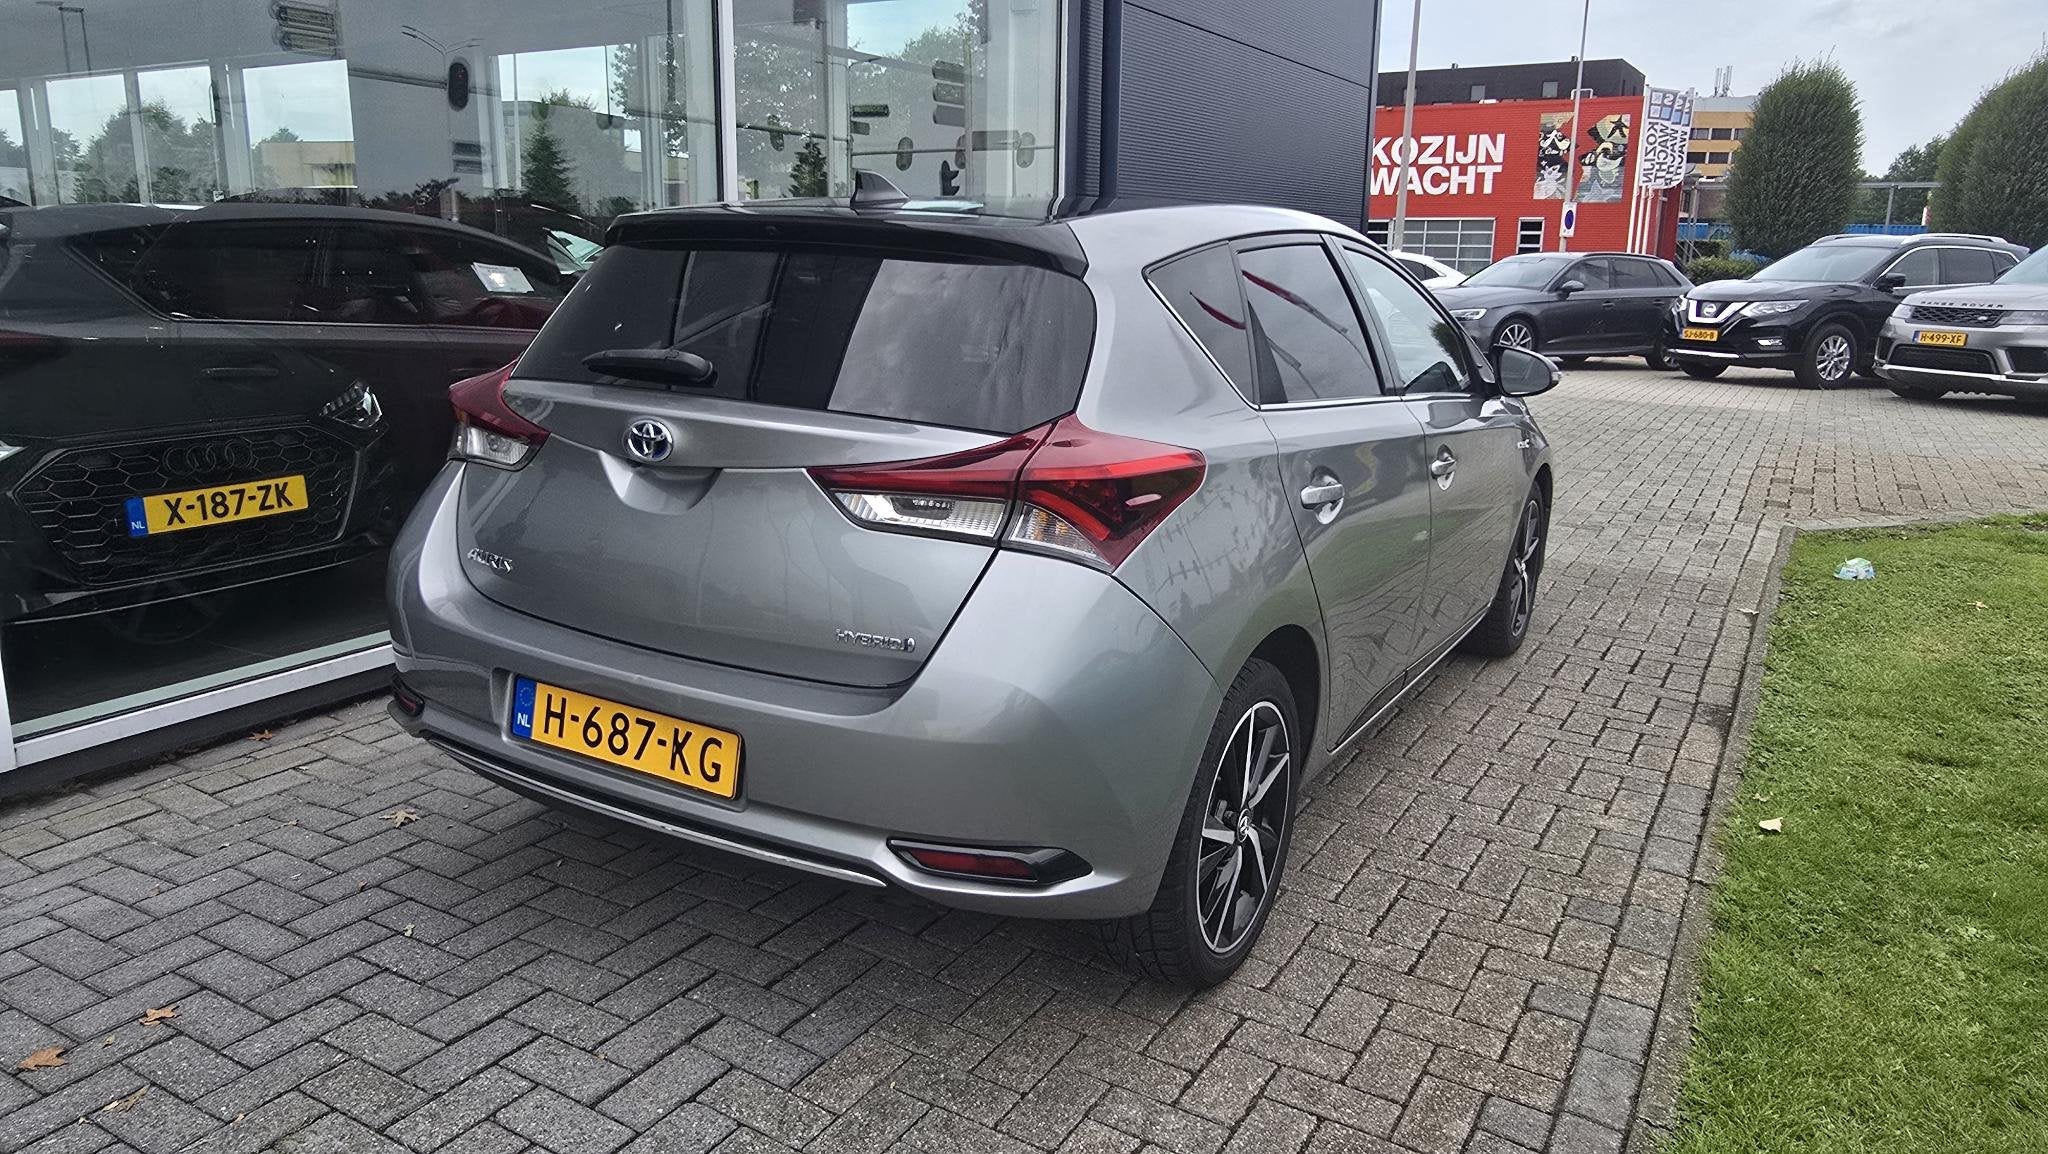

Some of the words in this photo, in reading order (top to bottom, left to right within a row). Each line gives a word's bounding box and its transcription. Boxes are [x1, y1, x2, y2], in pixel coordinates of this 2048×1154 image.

[1371, 133, 1505, 166] KOZIJN
[1370, 165, 1502, 196] WACHT
[1920, 333, 1963, 344] H-499-XF
[164, 481, 293, 526] X-187-ZK
[131, 520, 145, 531] NL
[836, 628, 902, 649] HYBRID
[517, 712, 531, 728] NL
[543, 692, 723, 784] H-687-KG
